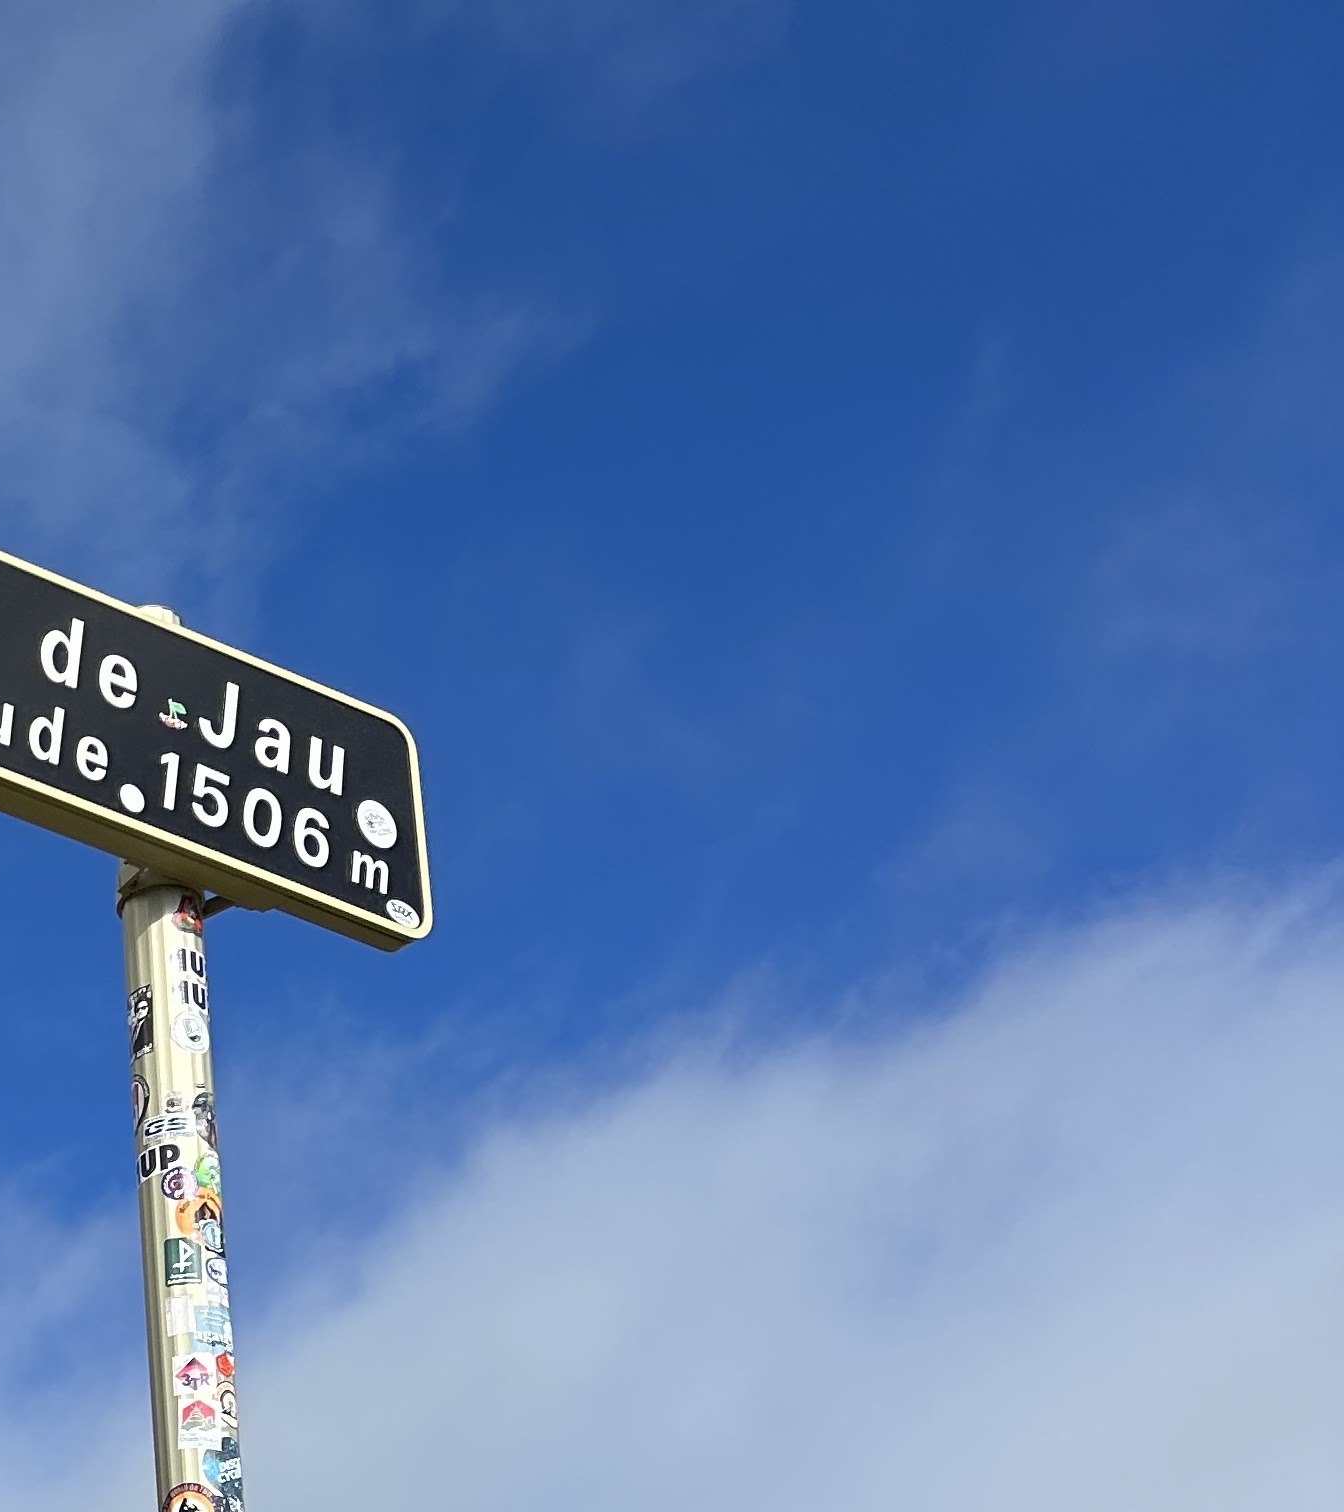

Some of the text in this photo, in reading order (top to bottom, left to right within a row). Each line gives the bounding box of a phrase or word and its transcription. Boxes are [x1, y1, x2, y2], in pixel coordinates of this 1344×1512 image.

[40, 617, 138, 709] de
[198, 681, 345, 796] Jau
[160, 752, 330, 868] 1506
[351, 850, 389, 895] m
[138, 1144, 181, 1180] UP
